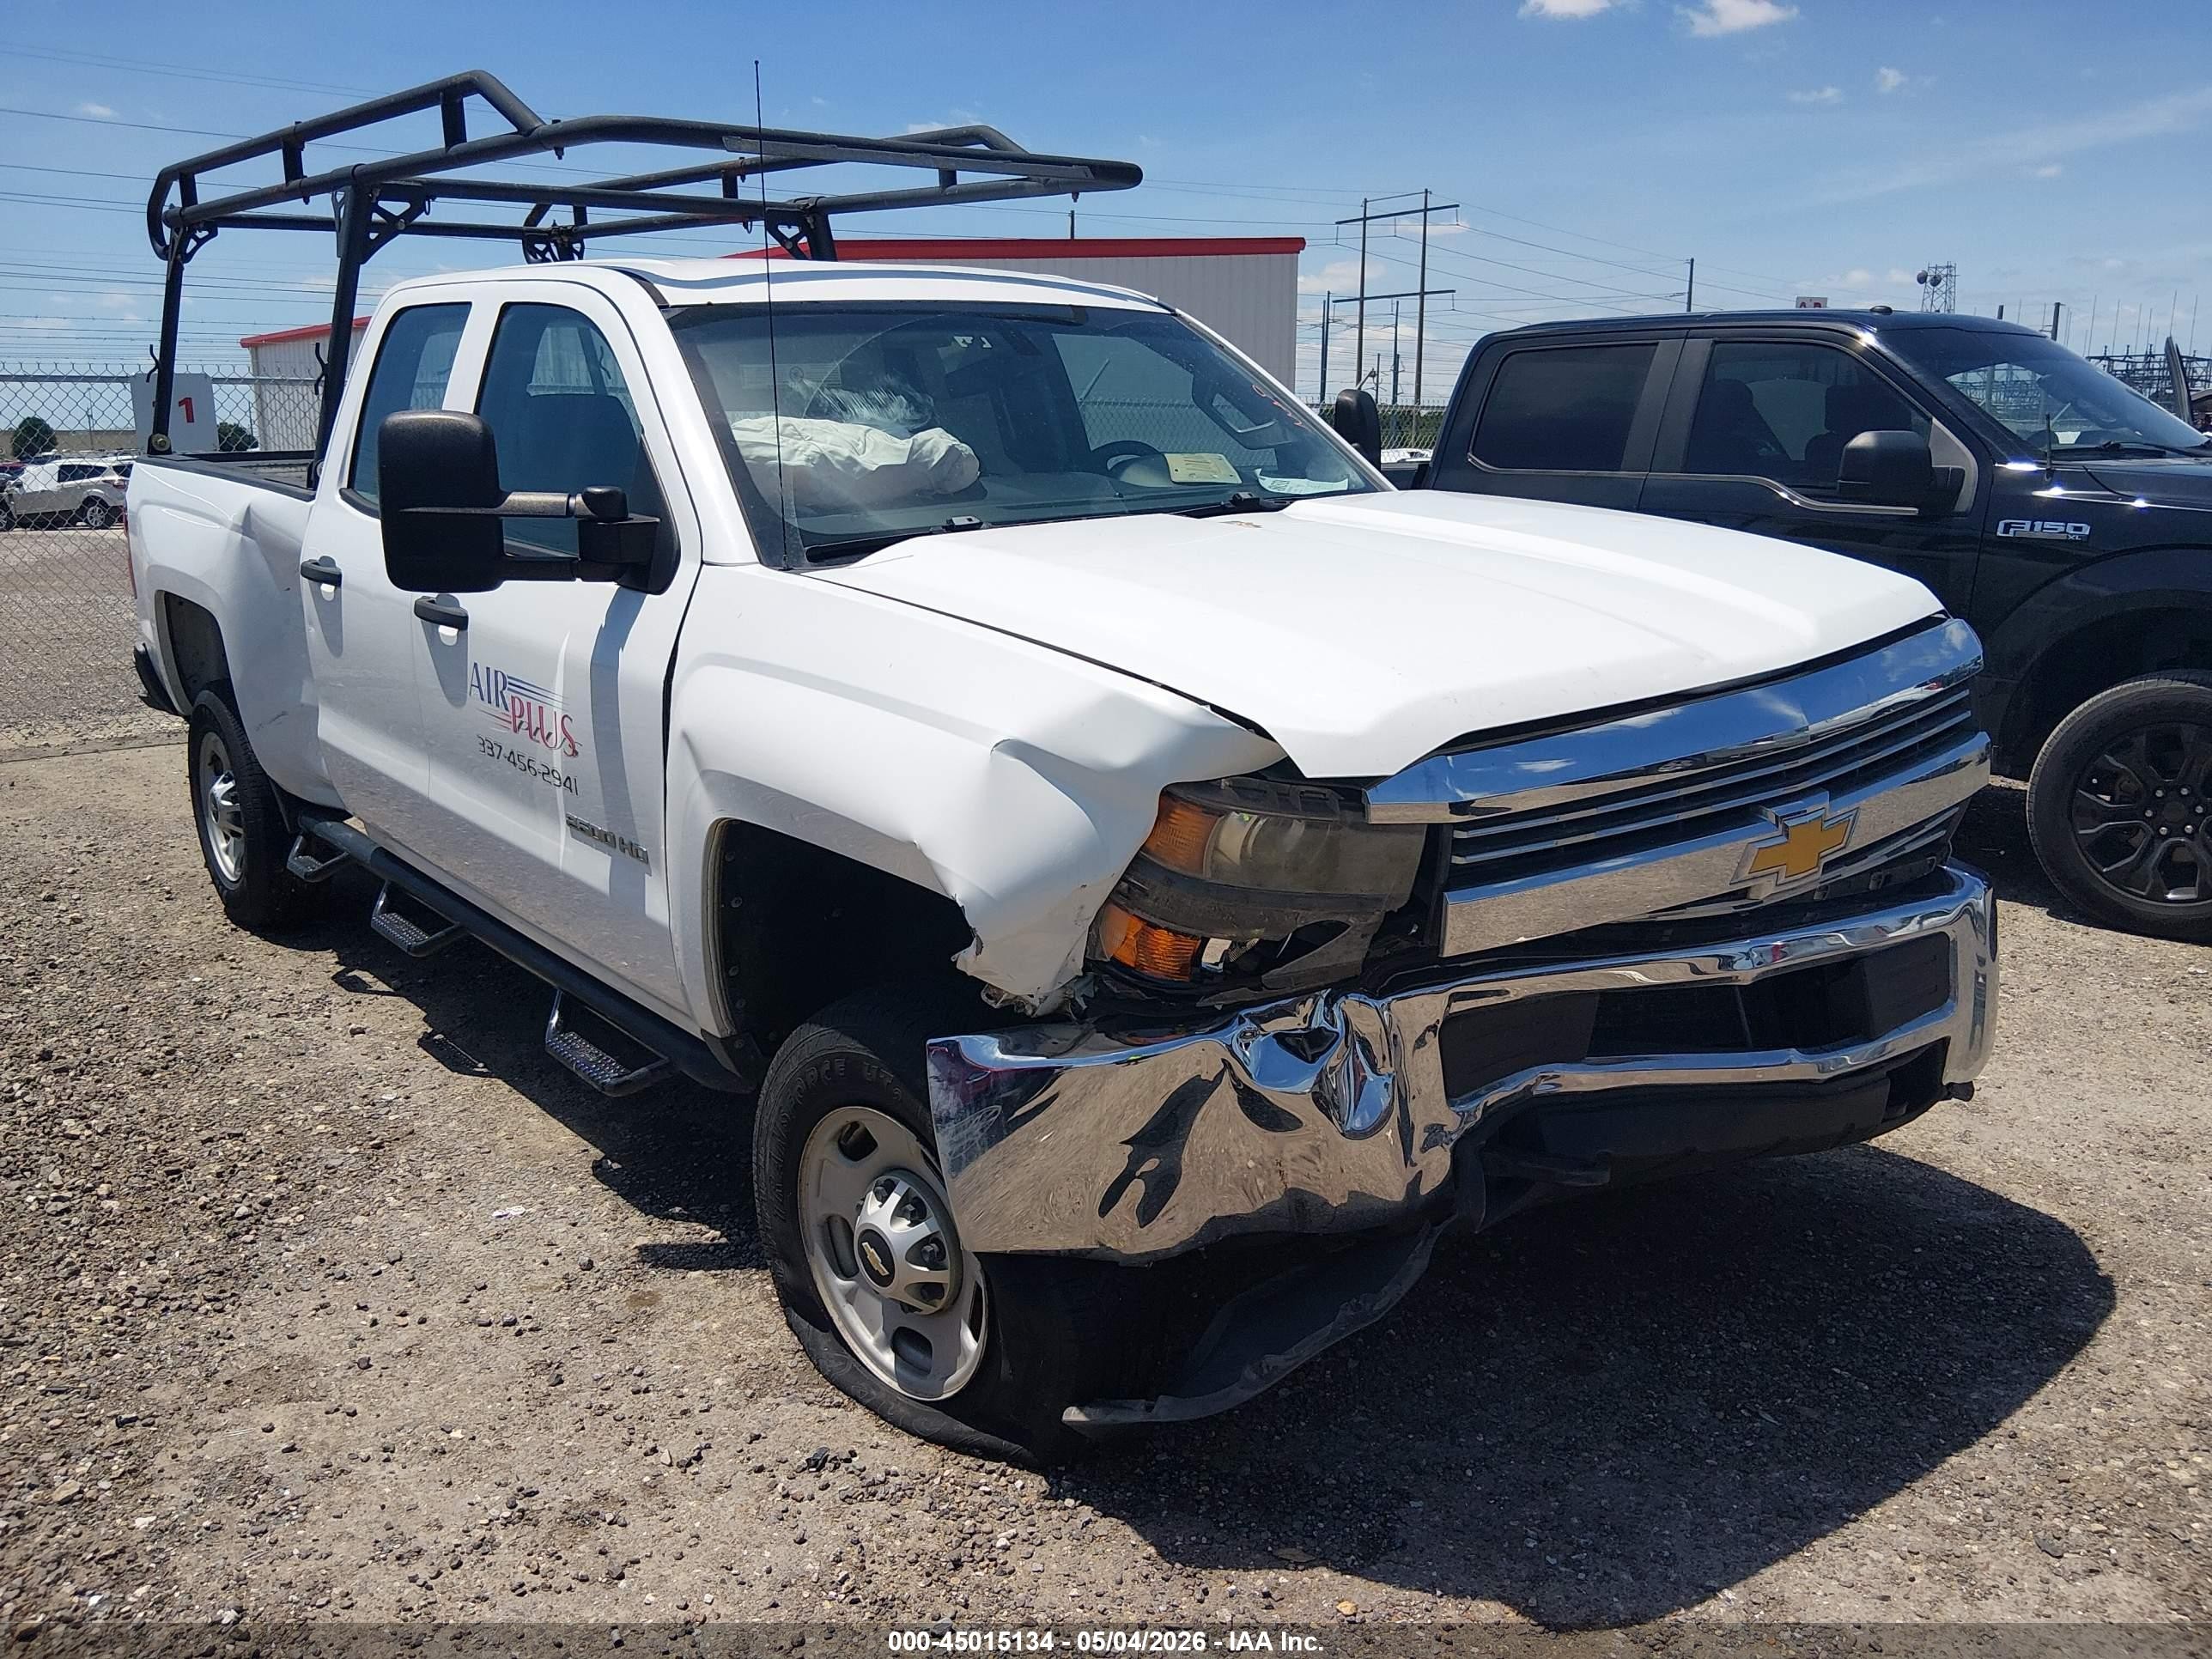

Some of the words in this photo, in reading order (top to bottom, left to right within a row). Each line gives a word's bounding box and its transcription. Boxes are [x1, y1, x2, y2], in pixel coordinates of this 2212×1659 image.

[470, 661, 510, 713] AIR
[510, 695, 583, 757] PLUS
[476, 733, 580, 797] 337-456-2941
